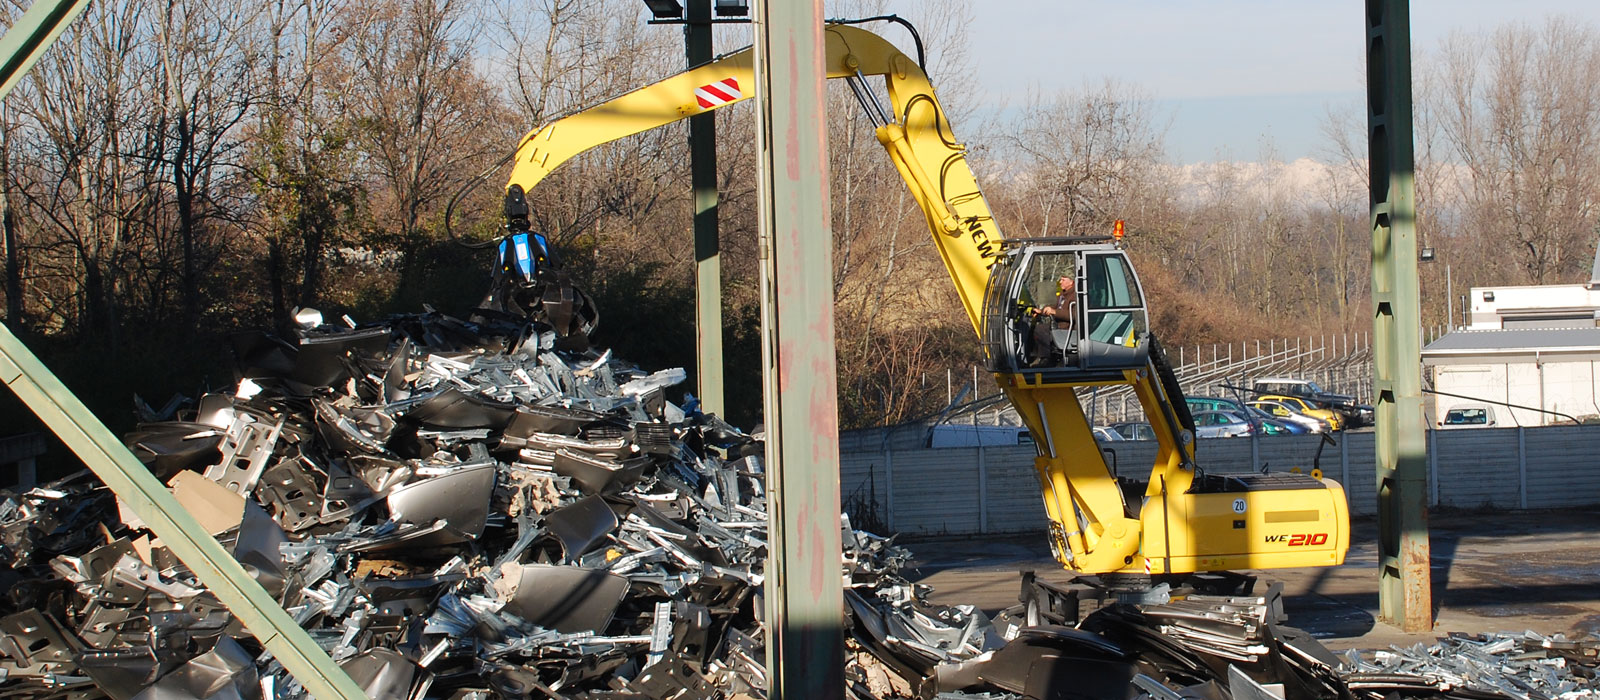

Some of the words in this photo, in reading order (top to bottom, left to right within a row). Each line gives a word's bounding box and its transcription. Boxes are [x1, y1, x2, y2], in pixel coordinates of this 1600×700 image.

[965, 215, 994, 259] NEW
[1235, 500, 1244, 511] 20
[1288, 533, 1328, 546] 210
